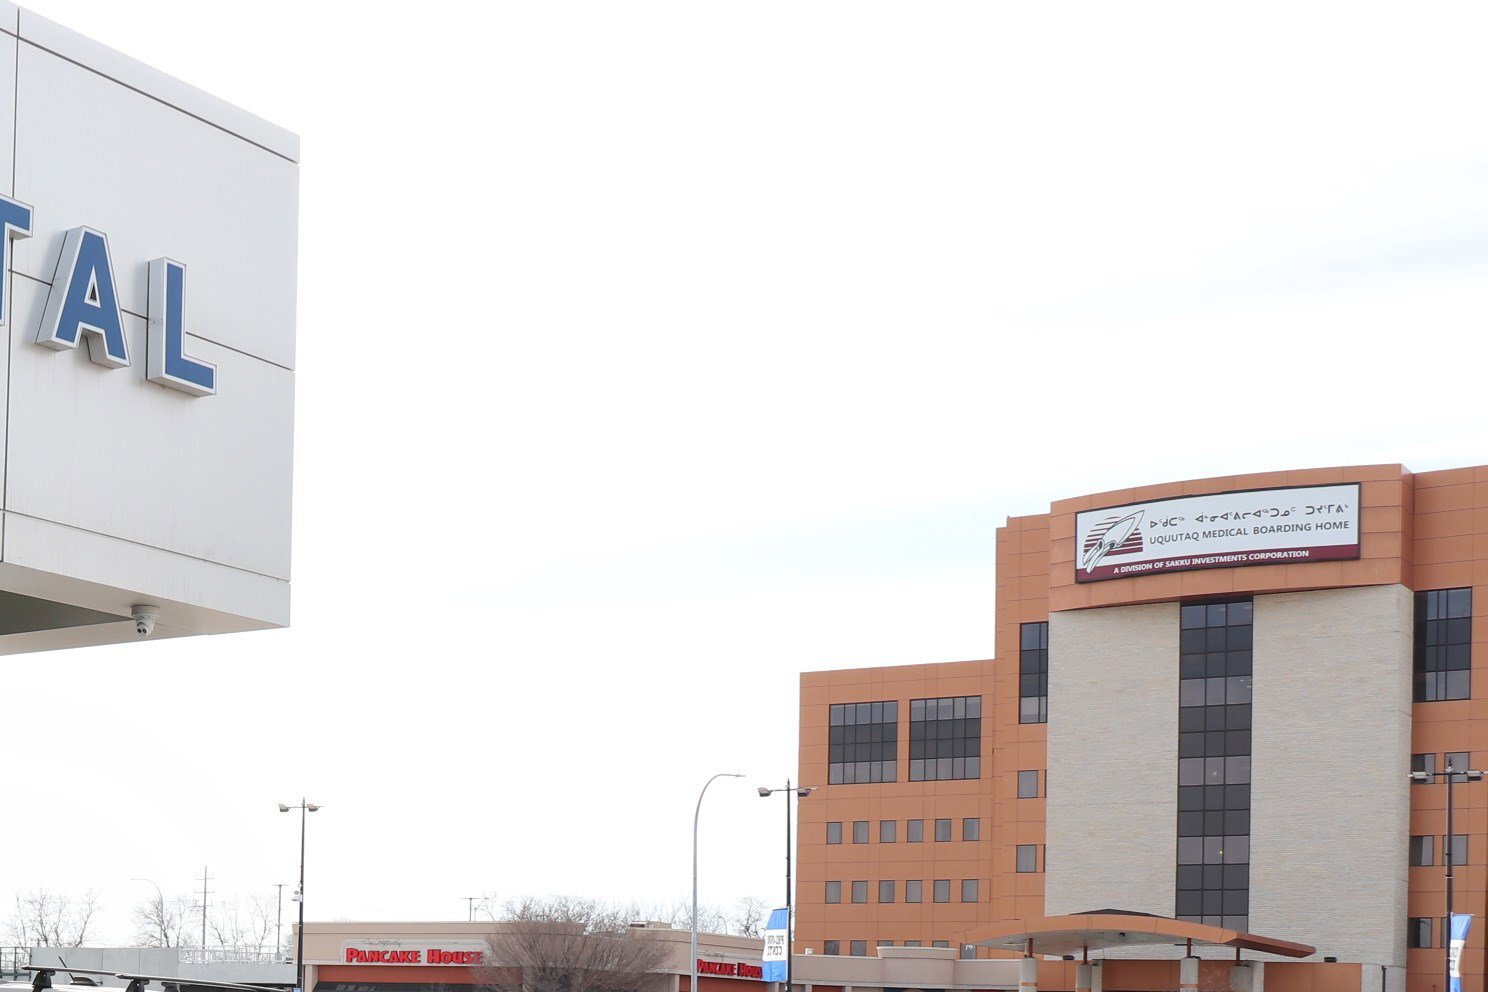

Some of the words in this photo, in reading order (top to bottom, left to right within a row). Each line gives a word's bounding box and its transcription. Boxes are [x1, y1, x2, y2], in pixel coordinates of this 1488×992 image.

[1149, 531, 1200, 545] UQUUTAQ
[1202, 527, 1249, 539] MEDICAL
[1253, 523, 1312, 535] BOARDING
[1315, 520, 1350, 531] HOME
[1120, 563, 1153, 573] DIVISION
[1154, 561, 1164, 569] OF
[1165, 558, 1191, 568] SAKKU
[1192, 553, 1247, 565] INVESTMENTS
[1248, 550, 1309, 560] CORPORATION
[346, 948, 421, 964] PANCAKE
